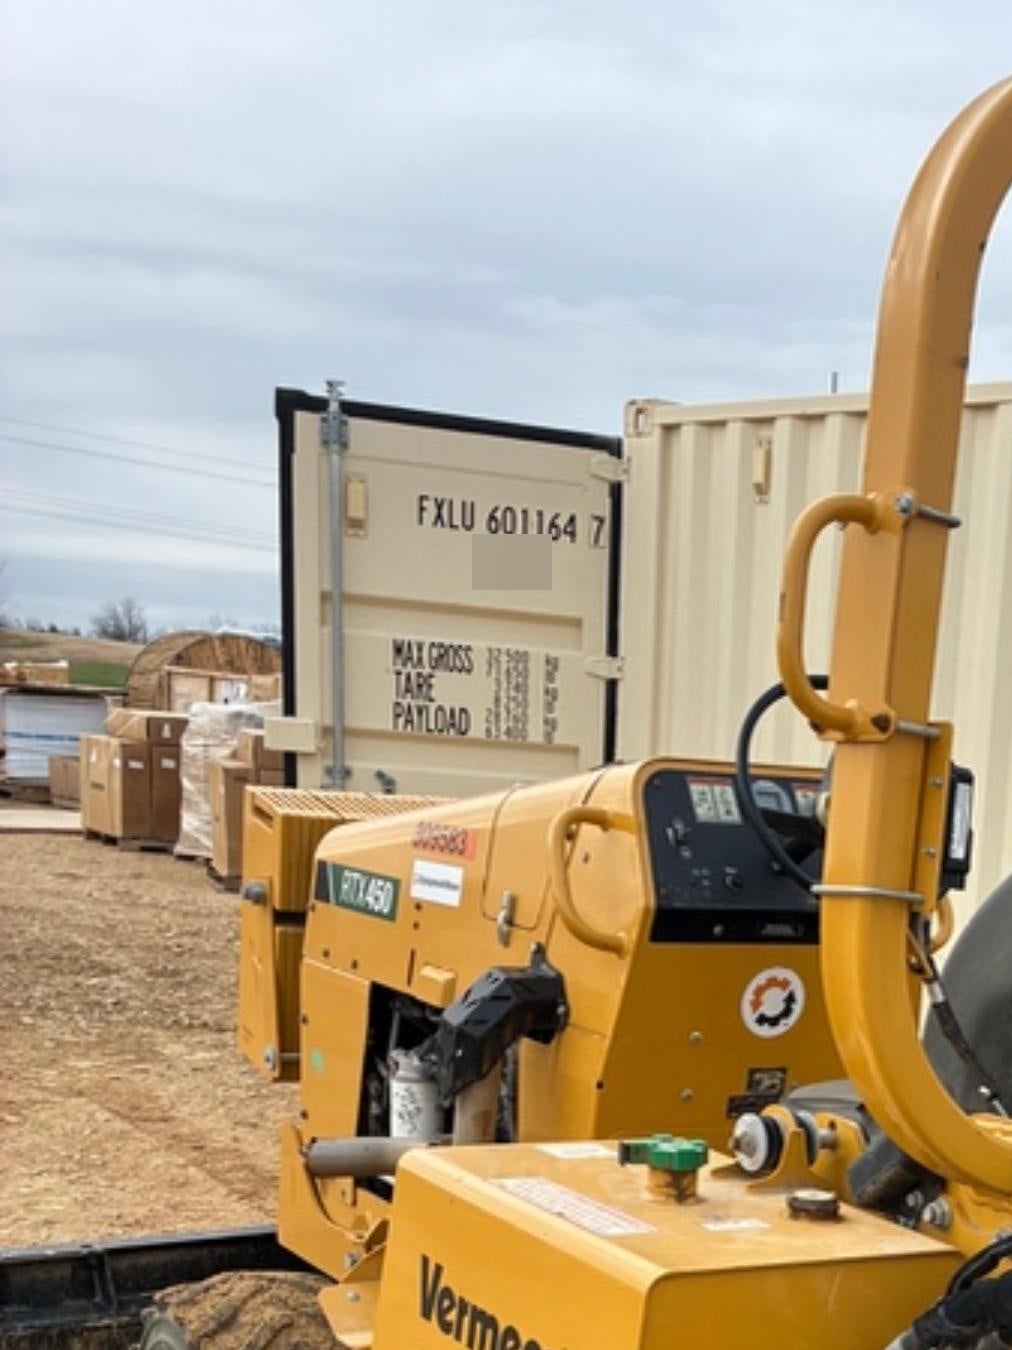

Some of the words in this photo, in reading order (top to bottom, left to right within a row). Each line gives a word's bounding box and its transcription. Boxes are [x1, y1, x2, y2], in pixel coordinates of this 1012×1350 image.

[417, 494, 475, 531] FXLU
[486, 505, 577, 543] 601164
[591, 513, 606, 546] 7
[392, 638, 427, 670] MAX
[428, 641, 474, 675] GROSS
[394, 670, 436, 702] TARE
[392, 701, 471, 736] PAYLOAD
